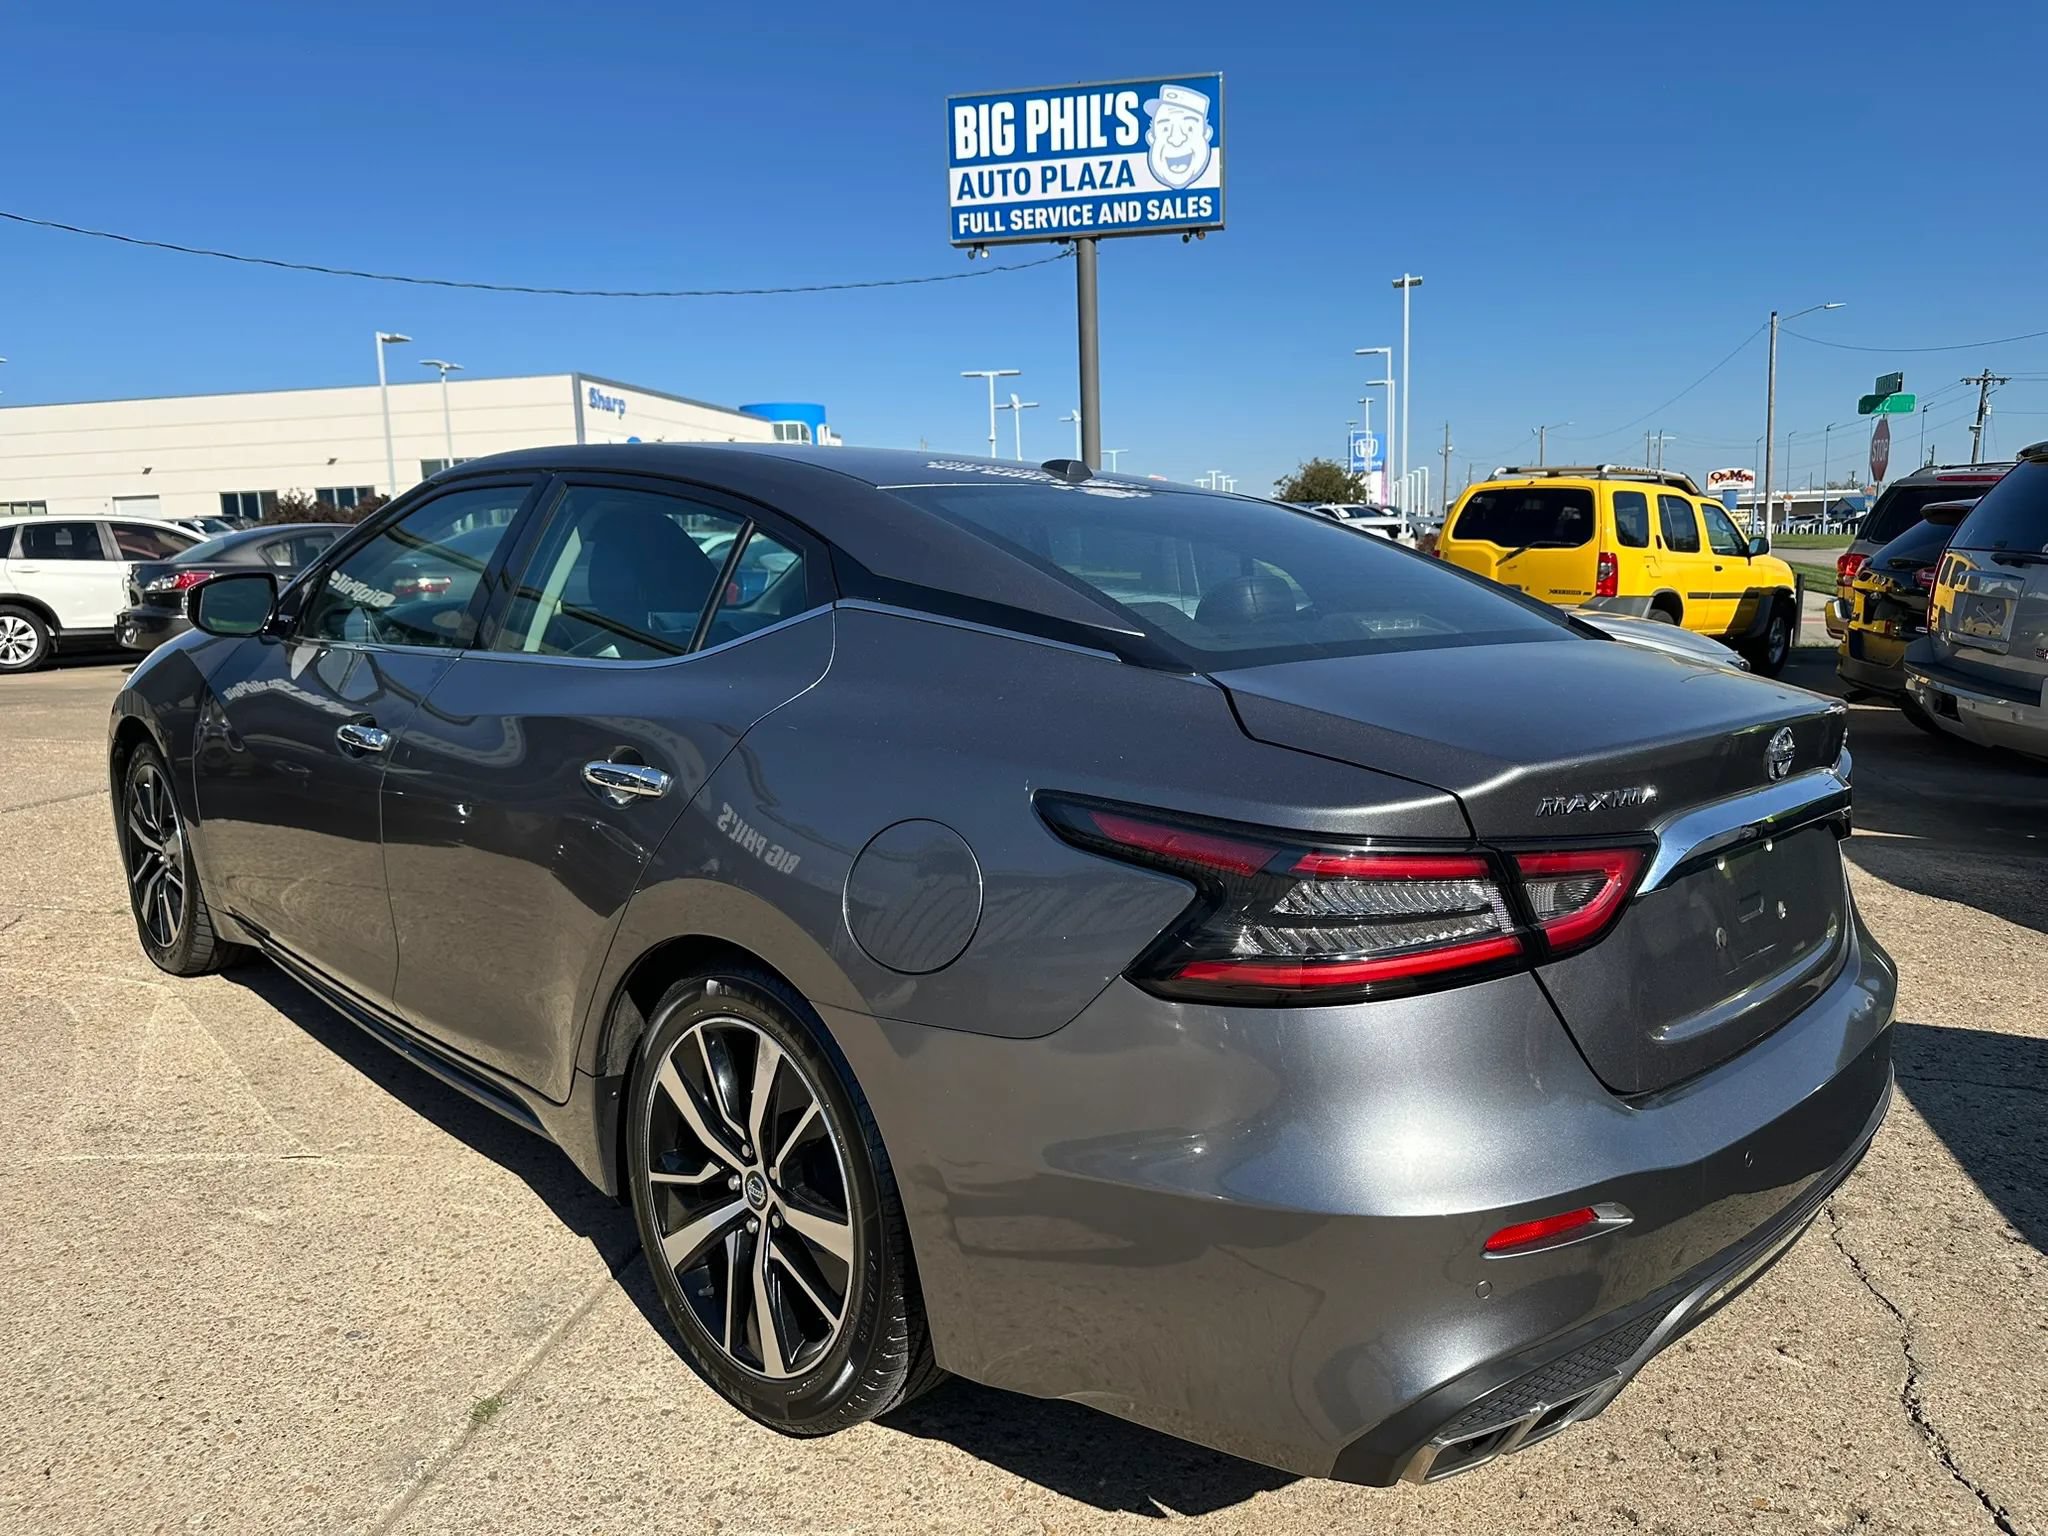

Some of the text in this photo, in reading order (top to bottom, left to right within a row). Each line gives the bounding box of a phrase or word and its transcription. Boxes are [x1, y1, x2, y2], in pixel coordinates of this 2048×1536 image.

[954, 90, 1140, 160] BIG PHIL'S
[956, 159, 1136, 200] AUTO PLAZA
[958, 196, 1212, 234] FULL SERVICE AND SALES
[589, 387, 625, 420] Sharp
[1871, 439, 1889, 462] STOP
[1535, 784, 1658, 817] MAXIMA
